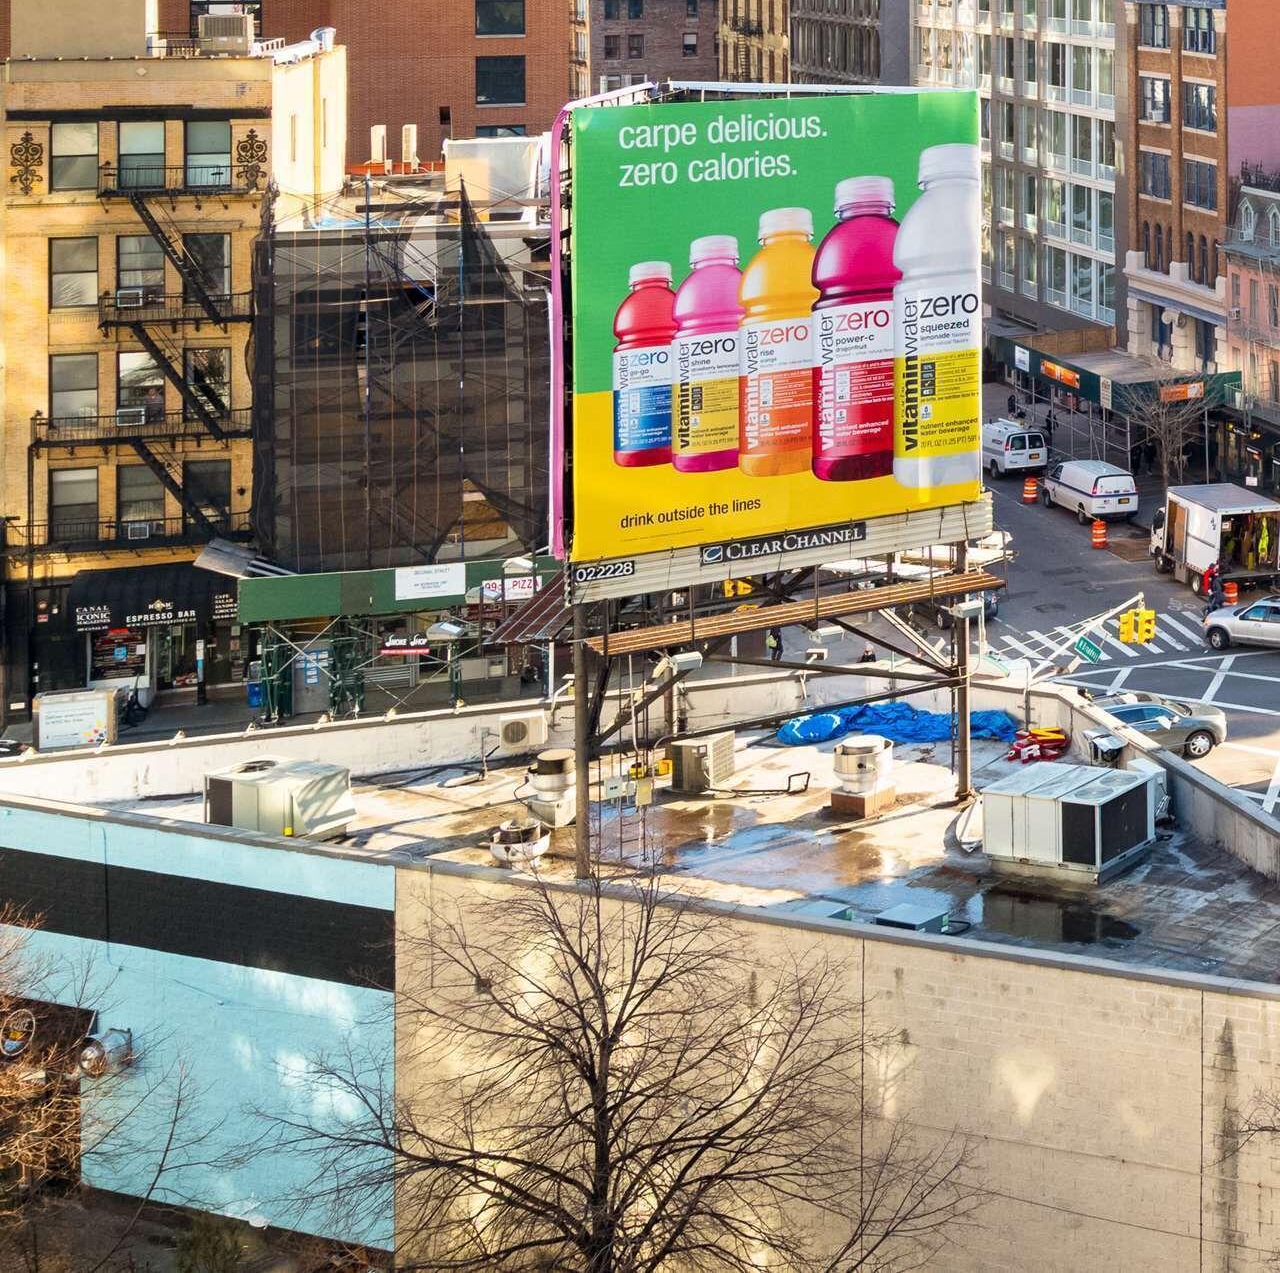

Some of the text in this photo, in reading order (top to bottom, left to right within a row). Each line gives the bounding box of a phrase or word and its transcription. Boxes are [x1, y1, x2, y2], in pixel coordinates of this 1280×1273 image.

[619, 113, 828, 153] carpe delicious.
[619, 150, 798, 187] zero calories.
[920, 293, 979, 319] zero
[835, 309, 890, 332] zero
[920, 319, 970, 334] squeezed
[760, 325, 809, 346] zero
[835, 333, 875, 346] power-c
[691, 337, 736, 357] zero
[630, 351, 669, 366] zero
[902, 297, 918, 451] vitaminwater
[621, 498, 761, 528] drink outside the lines
[575, 562, 634, 582] 022228
[77, 612, 110, 621] ICONIC
[126, 610, 196, 623] ESPRESSO BAR
[385, 633, 427, 646] SMOKE SHOP
